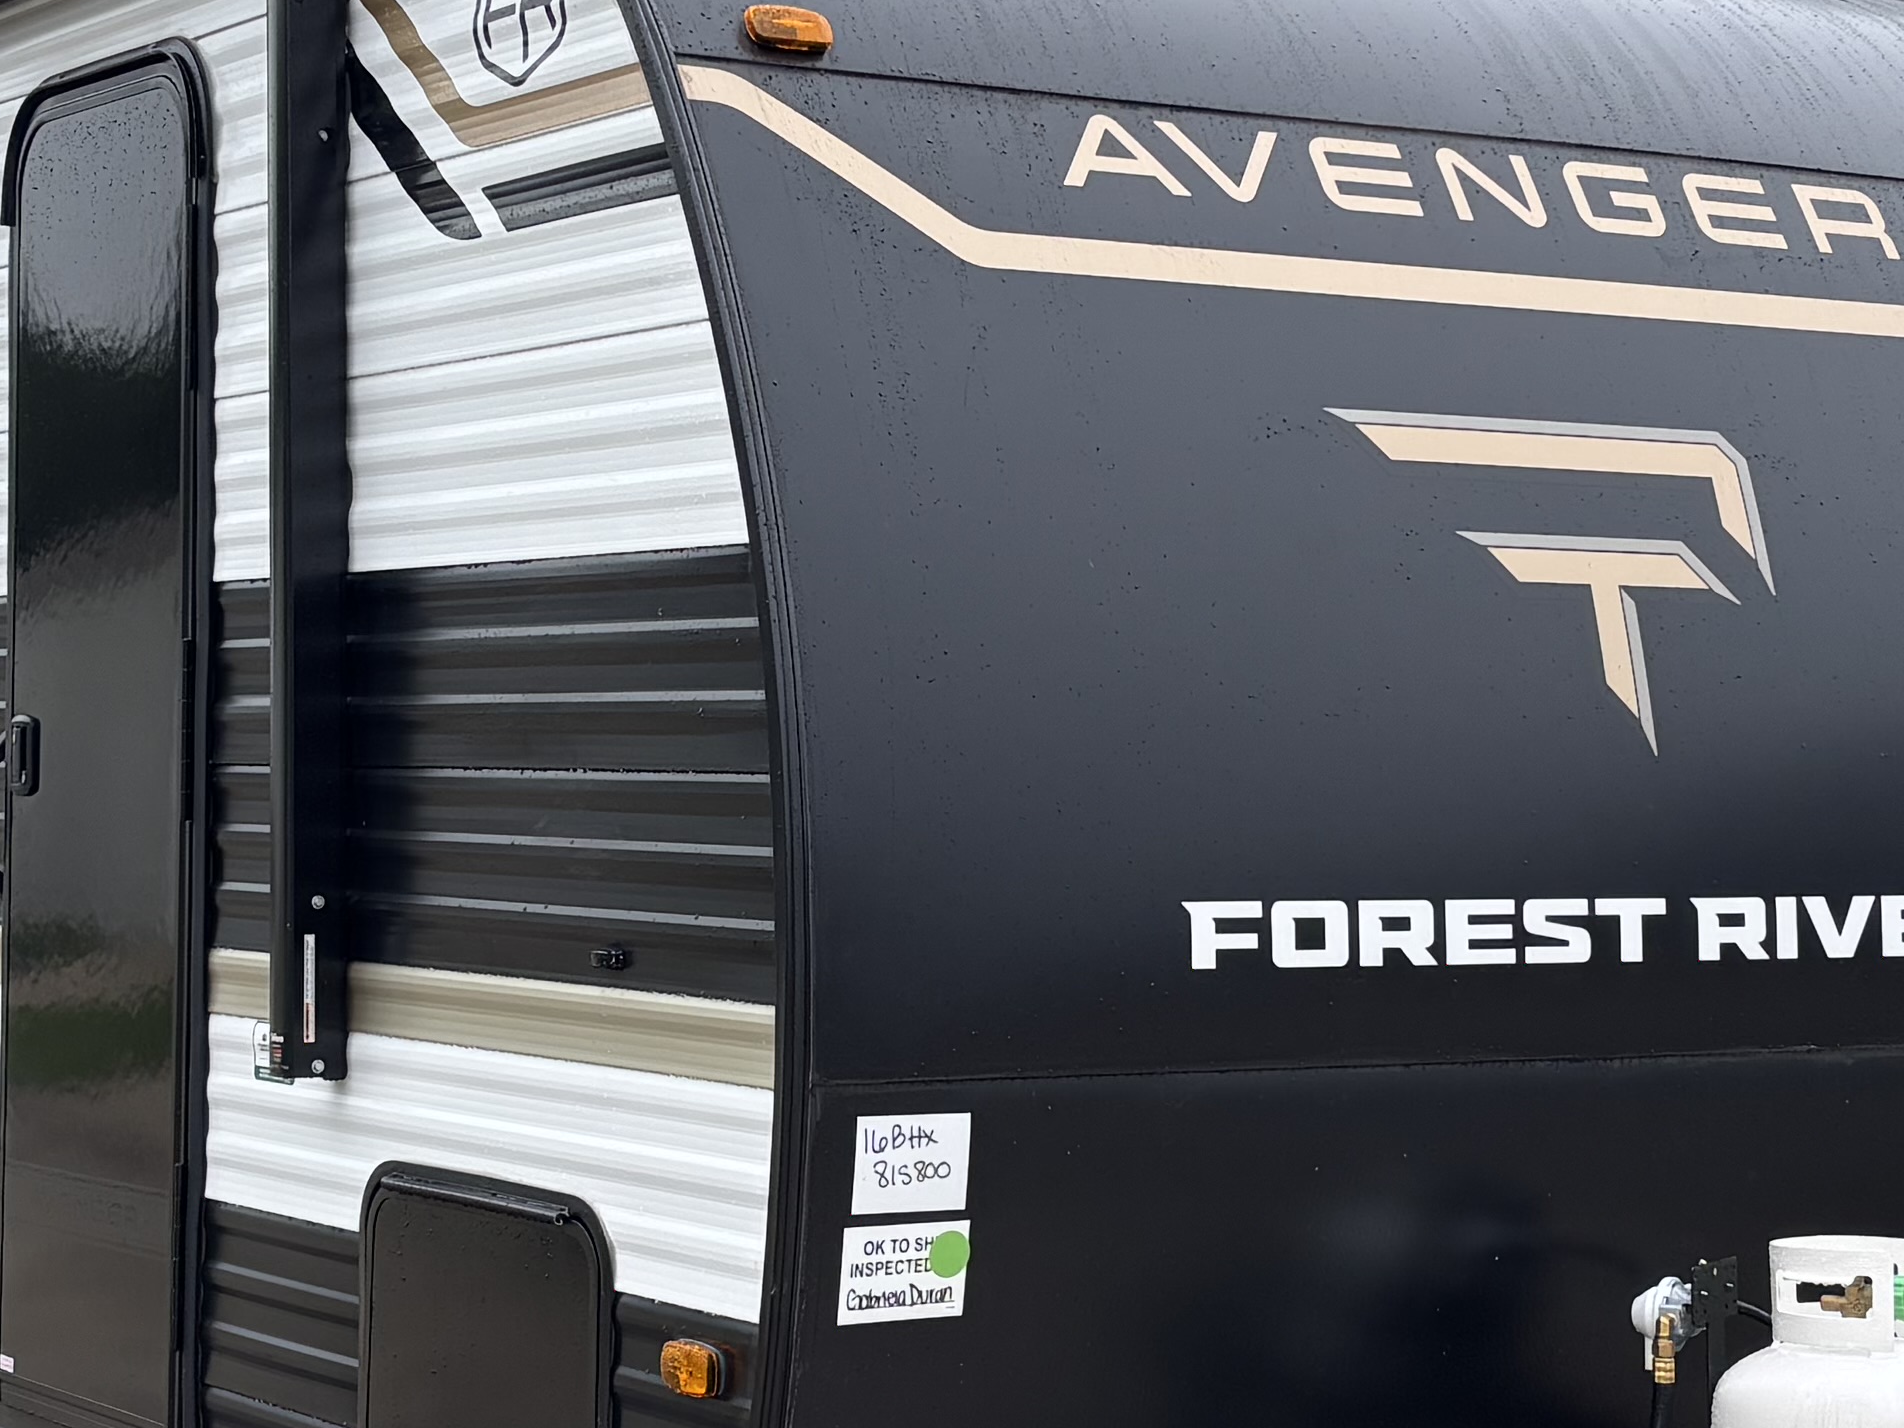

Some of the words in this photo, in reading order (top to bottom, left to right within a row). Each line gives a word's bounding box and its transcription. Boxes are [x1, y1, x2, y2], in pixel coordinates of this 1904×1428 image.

[1062, 113, 1901, 260] AVENGER
[1181, 897, 1668, 970] FOREST
[863, 1239, 885, 1256] OK
[890, 1237, 910, 1254] TO
[914, 1236, 938, 1252] SH
